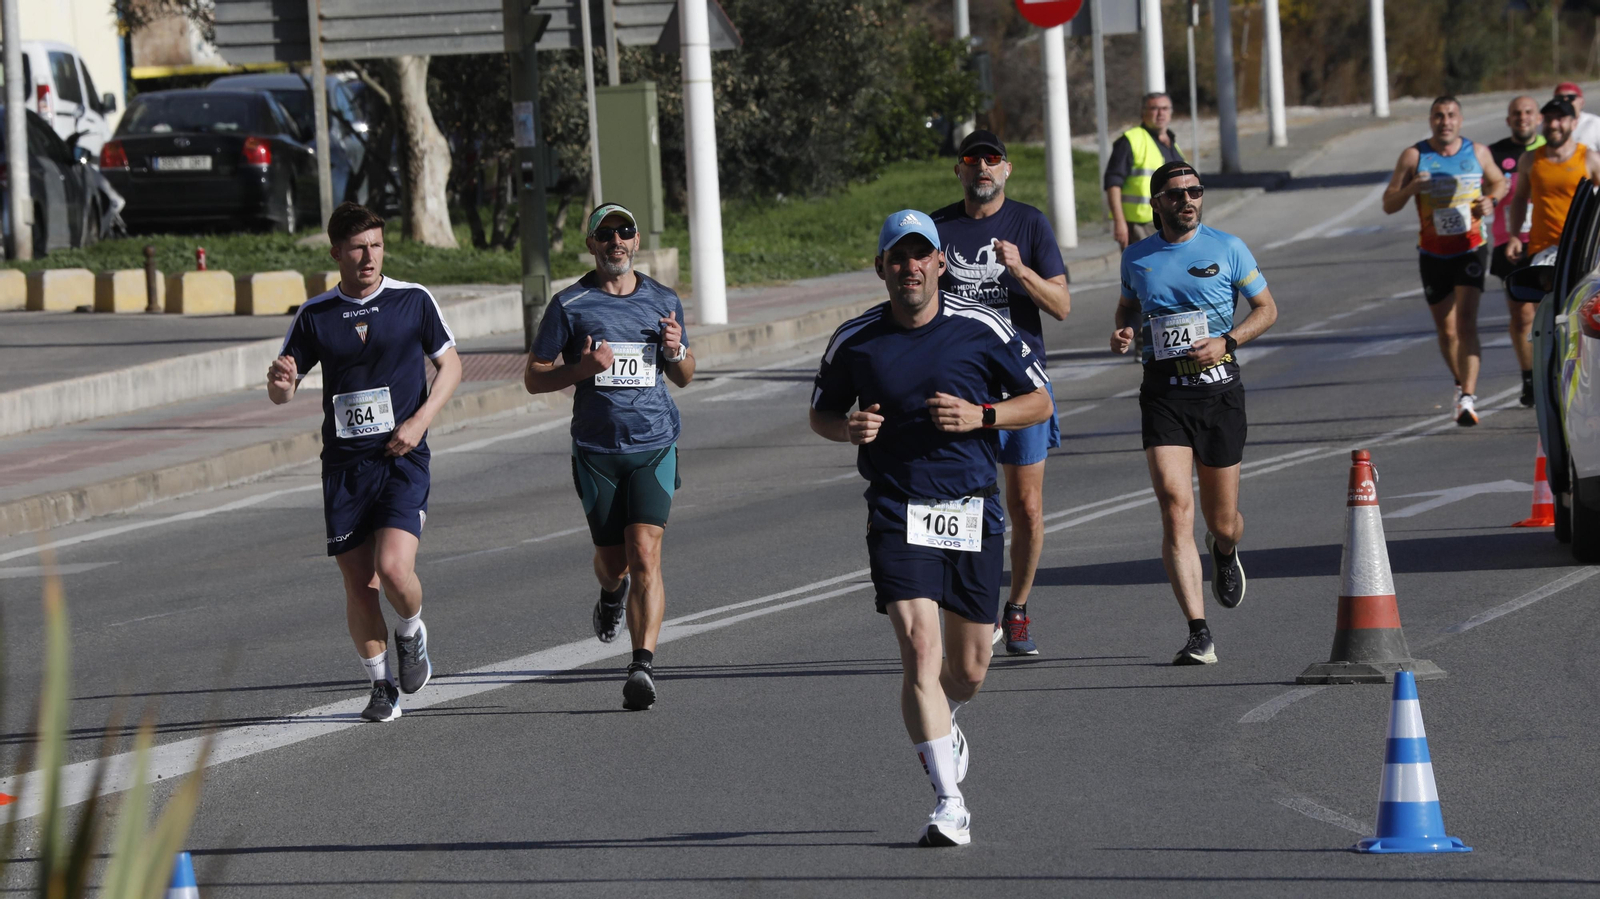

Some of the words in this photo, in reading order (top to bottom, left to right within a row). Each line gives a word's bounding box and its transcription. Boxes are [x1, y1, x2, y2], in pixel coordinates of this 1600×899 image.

[957, 283, 977, 291] MEDIA
[342, 306, 380, 319] GIVOVA
[1162, 328, 1191, 348] 224
[612, 358, 638, 376] 170
[345, 406, 375, 427] 264
[351, 426, 379, 435] EVOS
[923, 513, 959, 536] 106
[926, 538, 961, 548] EVOS
